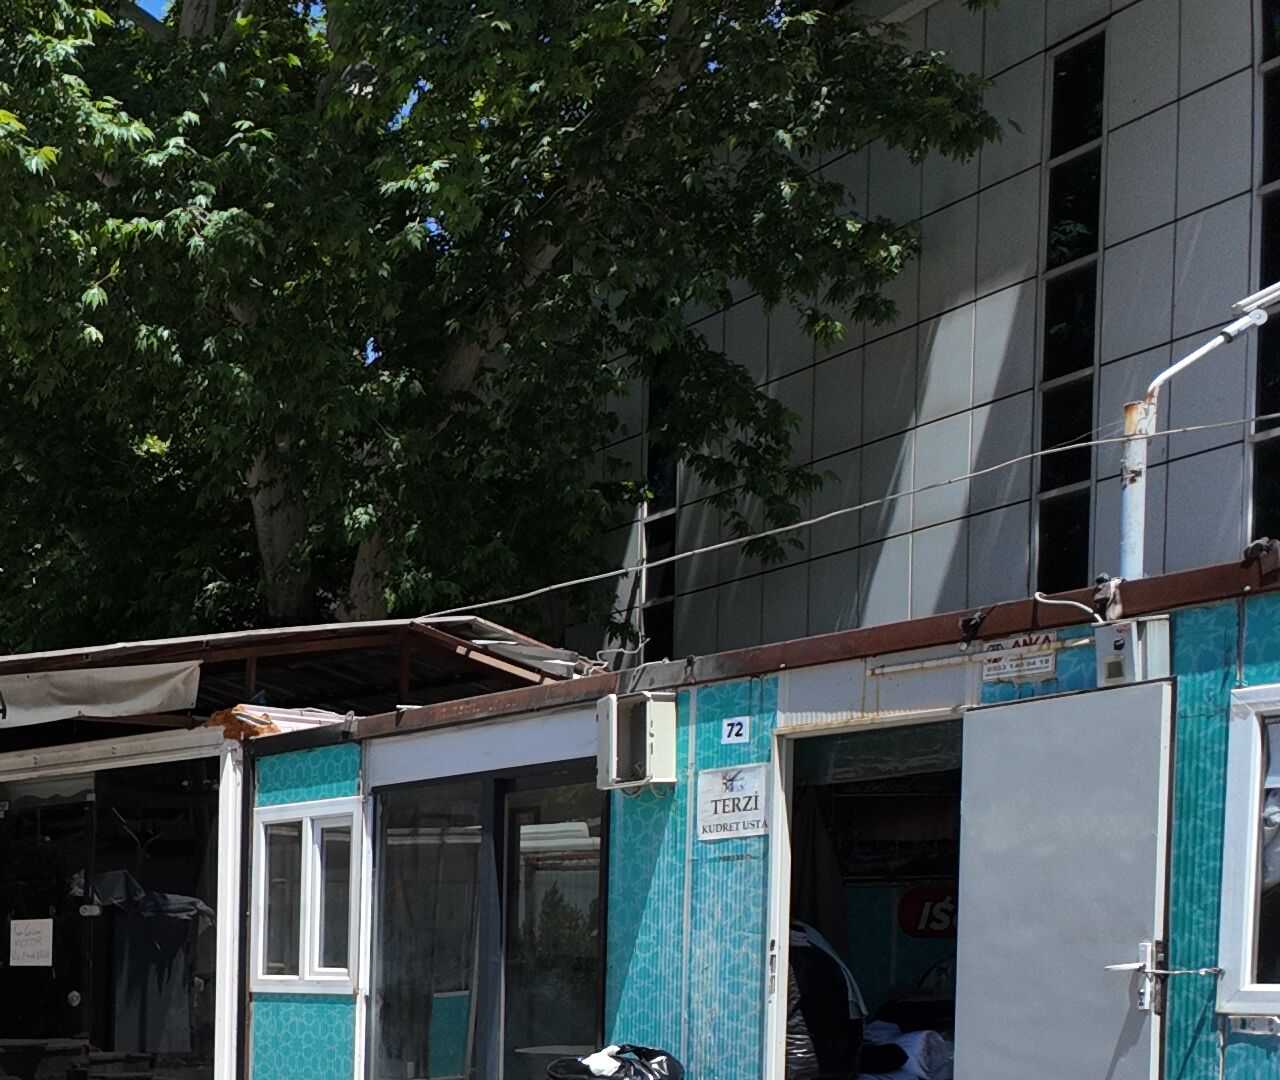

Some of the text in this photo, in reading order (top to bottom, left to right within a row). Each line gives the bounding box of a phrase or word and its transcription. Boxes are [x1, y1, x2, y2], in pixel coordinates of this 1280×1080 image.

[726, 721, 744, 738] 72
[710, 791, 760, 814] TERZİ
[701, 818, 769, 834] KUDRET USTA
